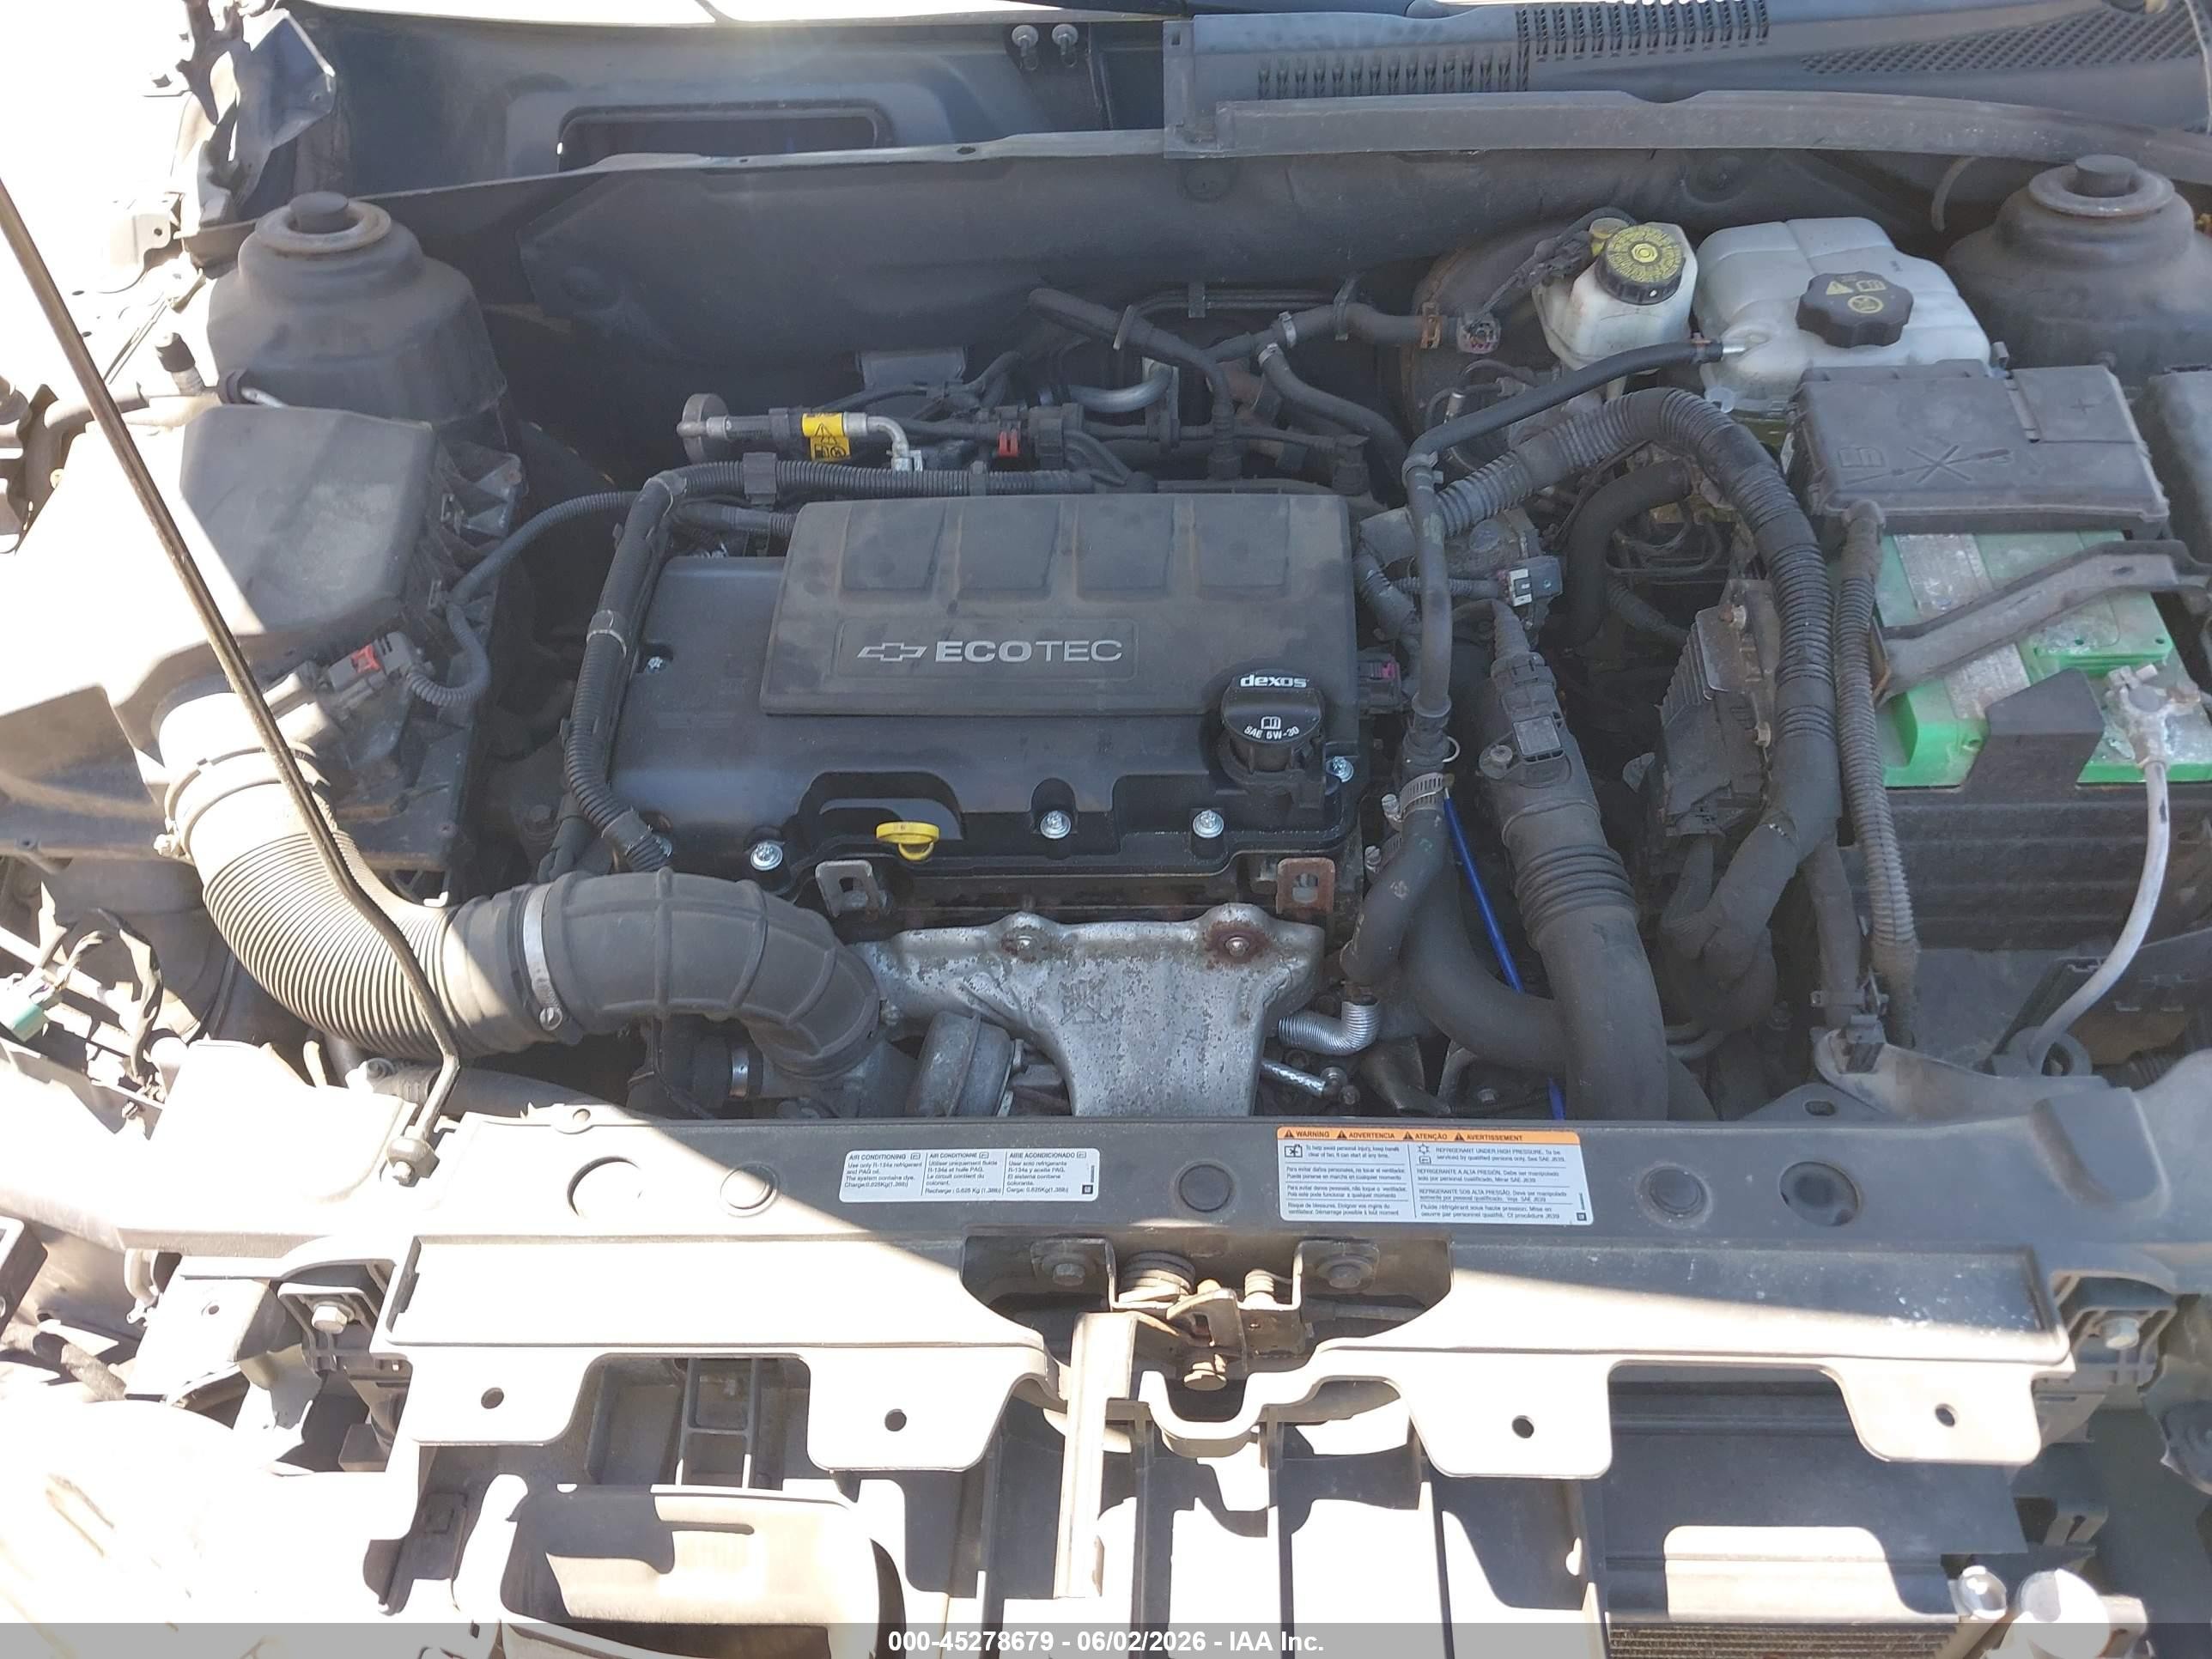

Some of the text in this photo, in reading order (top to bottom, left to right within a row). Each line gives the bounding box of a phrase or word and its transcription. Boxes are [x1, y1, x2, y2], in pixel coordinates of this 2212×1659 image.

[935, 641, 1122, 662] ECOTEC
[1241, 674, 1307, 688] dexos
[1244, 725, 1299, 739] SAE 5W-30
